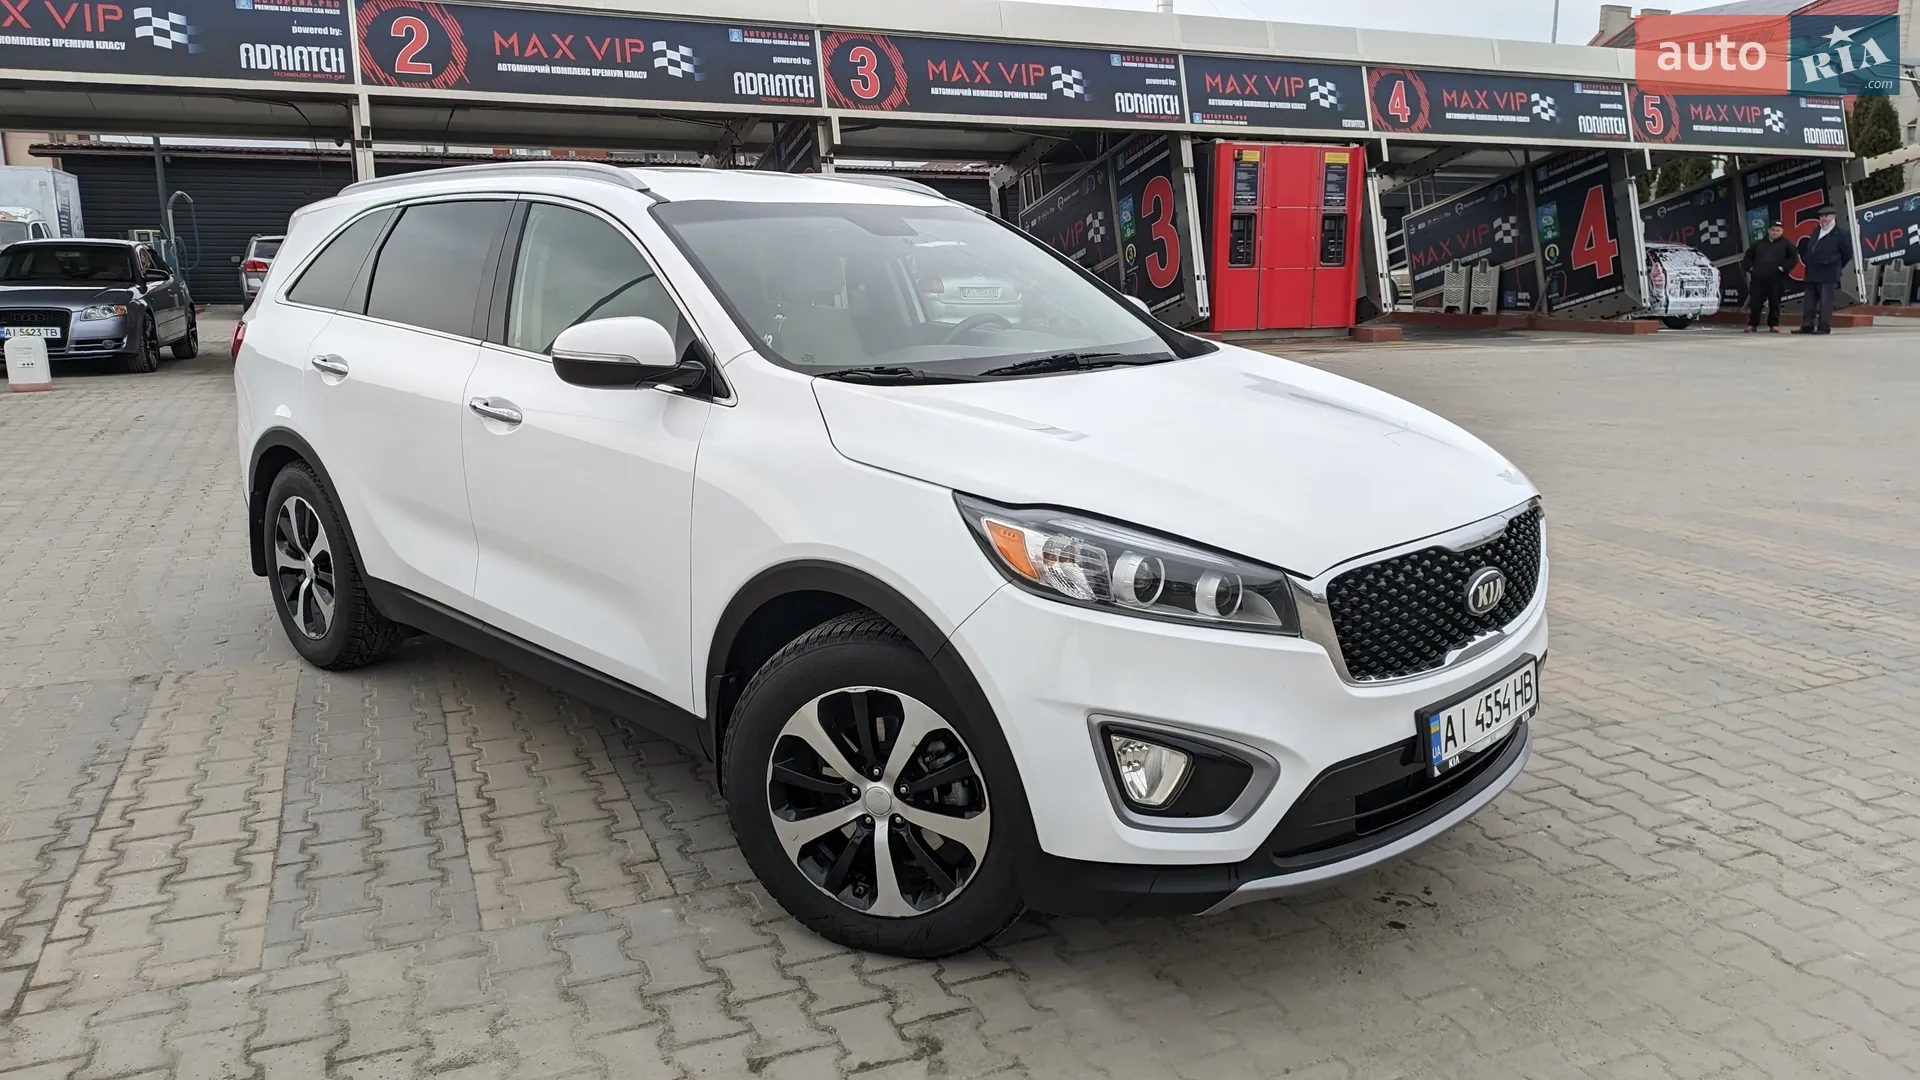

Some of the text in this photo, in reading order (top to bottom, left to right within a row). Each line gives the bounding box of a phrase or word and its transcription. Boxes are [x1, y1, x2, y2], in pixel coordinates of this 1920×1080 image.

[44, 1, 124, 32] VIP
[292, 26, 342, 36] powered by:
[52, 38, 94, 49] ПРЕМІУМ
[96, 41, 126, 50] КЛАСУ
[391, 16, 432, 74] 2
[493, 30, 646, 64] MAX VIP
[497, 63, 648, 79] АВТОМИЮЧИЙ КОМПЛЕКС ПРЕМІУМ КЛАСУ
[773, 56, 802, 64] powered
[849, 46, 880, 99] 3
[926, 58, 1045, 86] MAX VIP
[1205, 72, 1304, 97] MAX VIP
[1388, 81, 1410, 122] 4
[1442, 88, 1528, 111] MAX VIP
[1690, 103, 1761, 124] MAX VIP
[1643, 95, 1665, 135] 5
[1059, 219, 1083, 250] VIP
[1141, 175, 1180, 289] 3
[1412, 237, 1452, 270] MAX
[1457, 222, 1489, 250] VIP
[1571, 184, 1619, 279] 4
[1780, 189, 1825, 281] 5
[1865, 228, 1904, 252] VIP
[1128, 247, 1134, 260] 3
[5, 328, 16, 337] AI
[43, 328, 58, 337] TB
[1477, 577, 1503, 608] KIA
[1445, 669, 1533, 754] AI 4554 HB
[1432, 745, 1441, 758] UA
[1448, 755, 1460, 769] KIA
